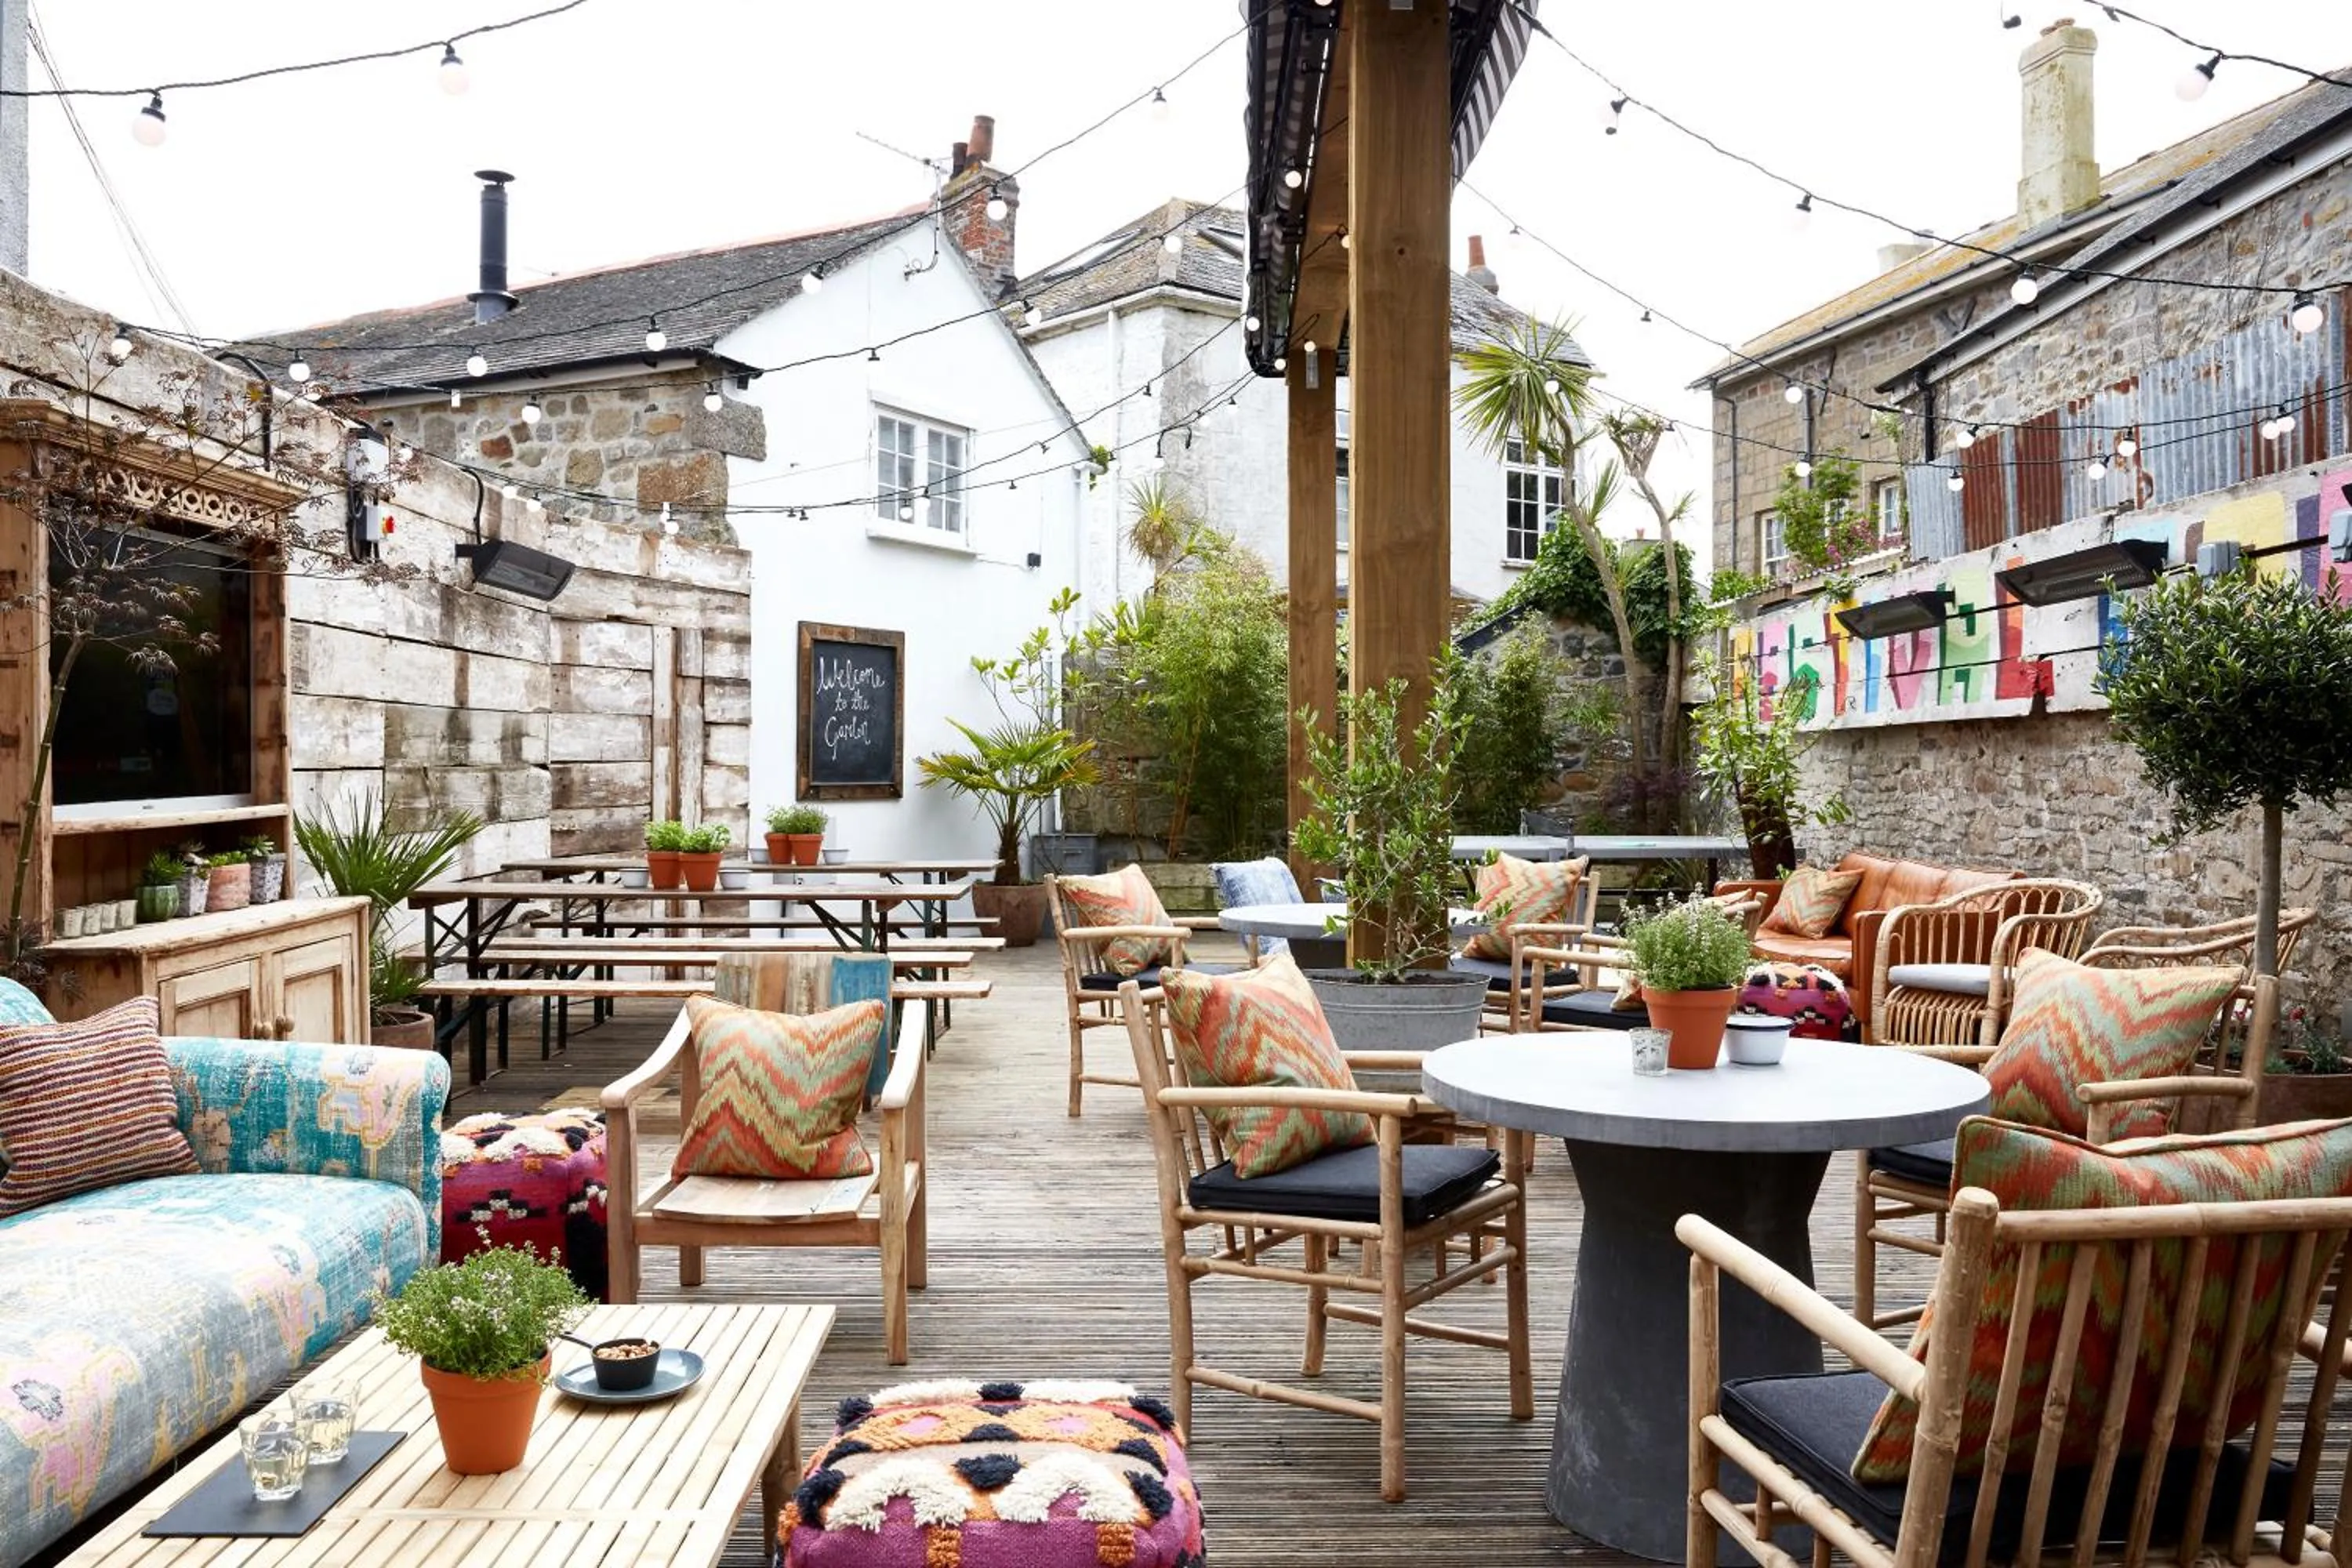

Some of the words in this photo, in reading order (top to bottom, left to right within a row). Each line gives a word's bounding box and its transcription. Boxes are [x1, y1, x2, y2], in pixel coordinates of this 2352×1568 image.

[816, 657, 885, 695] Welcome
[835, 691, 848, 711] to
[851, 689, 870, 710] the
[825, 716, 871, 761] Garden
